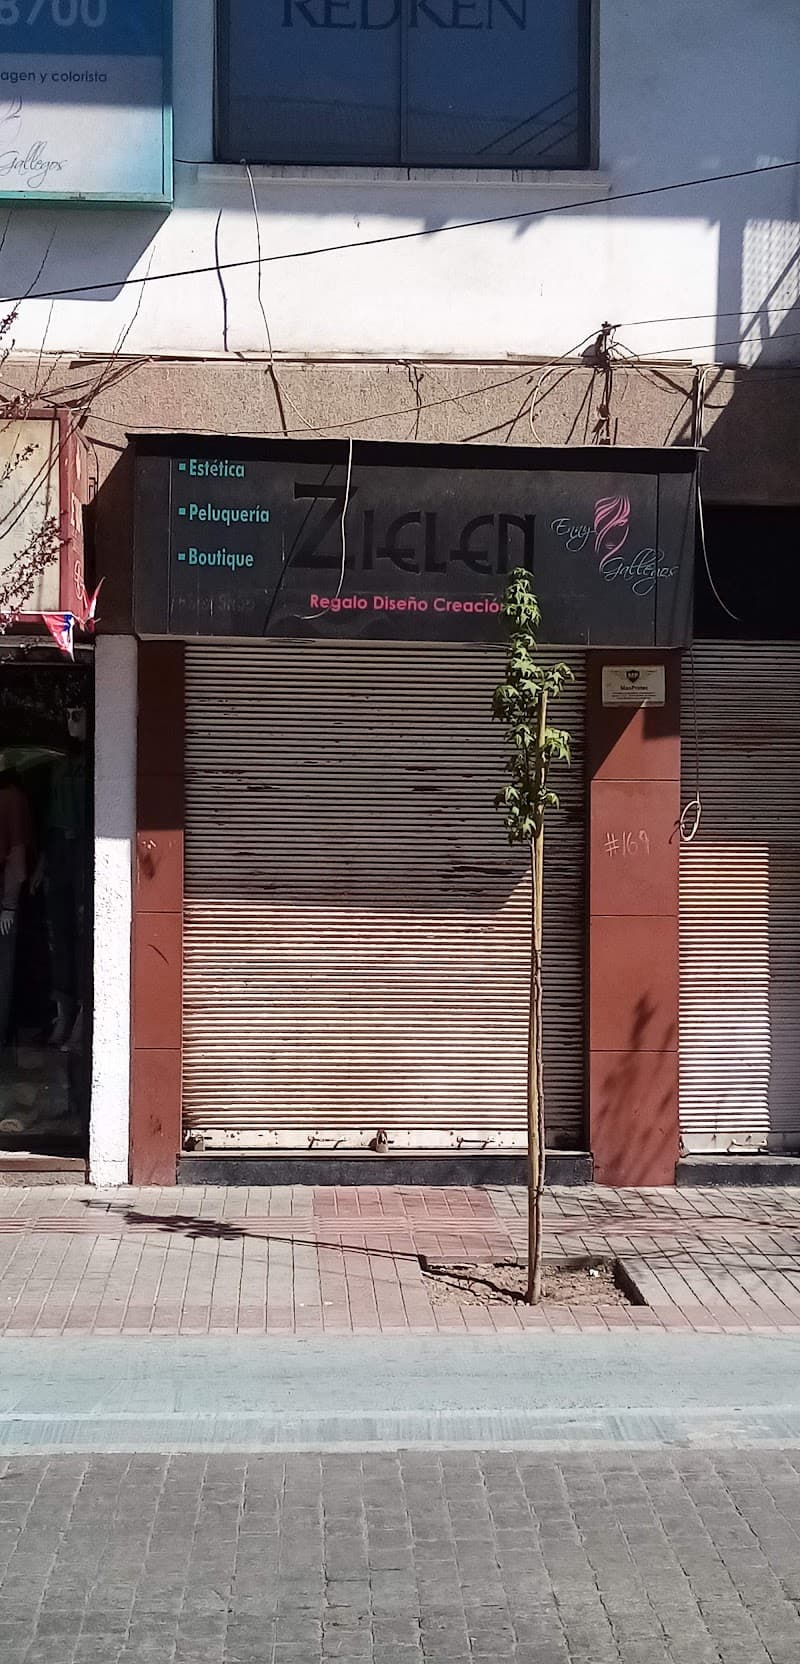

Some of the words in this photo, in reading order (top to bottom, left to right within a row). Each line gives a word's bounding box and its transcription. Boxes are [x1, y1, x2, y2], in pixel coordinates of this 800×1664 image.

[1, 71, 36, 84] agen
[40, 72, 47, 84] y
[52, 71, 108, 83] colorista
[189, 458, 245, 478] Estética
[189, 503, 270, 526] Peluquería
[550, 517, 596, 552] Enny
[189, 547, 255, 570] Boutique
[601, 547, 680, 596] Gallegos
[310, 593, 368, 612] Regalo
[373, 595, 428, 612] Diseño
[604, 830, 650, 857] #169
